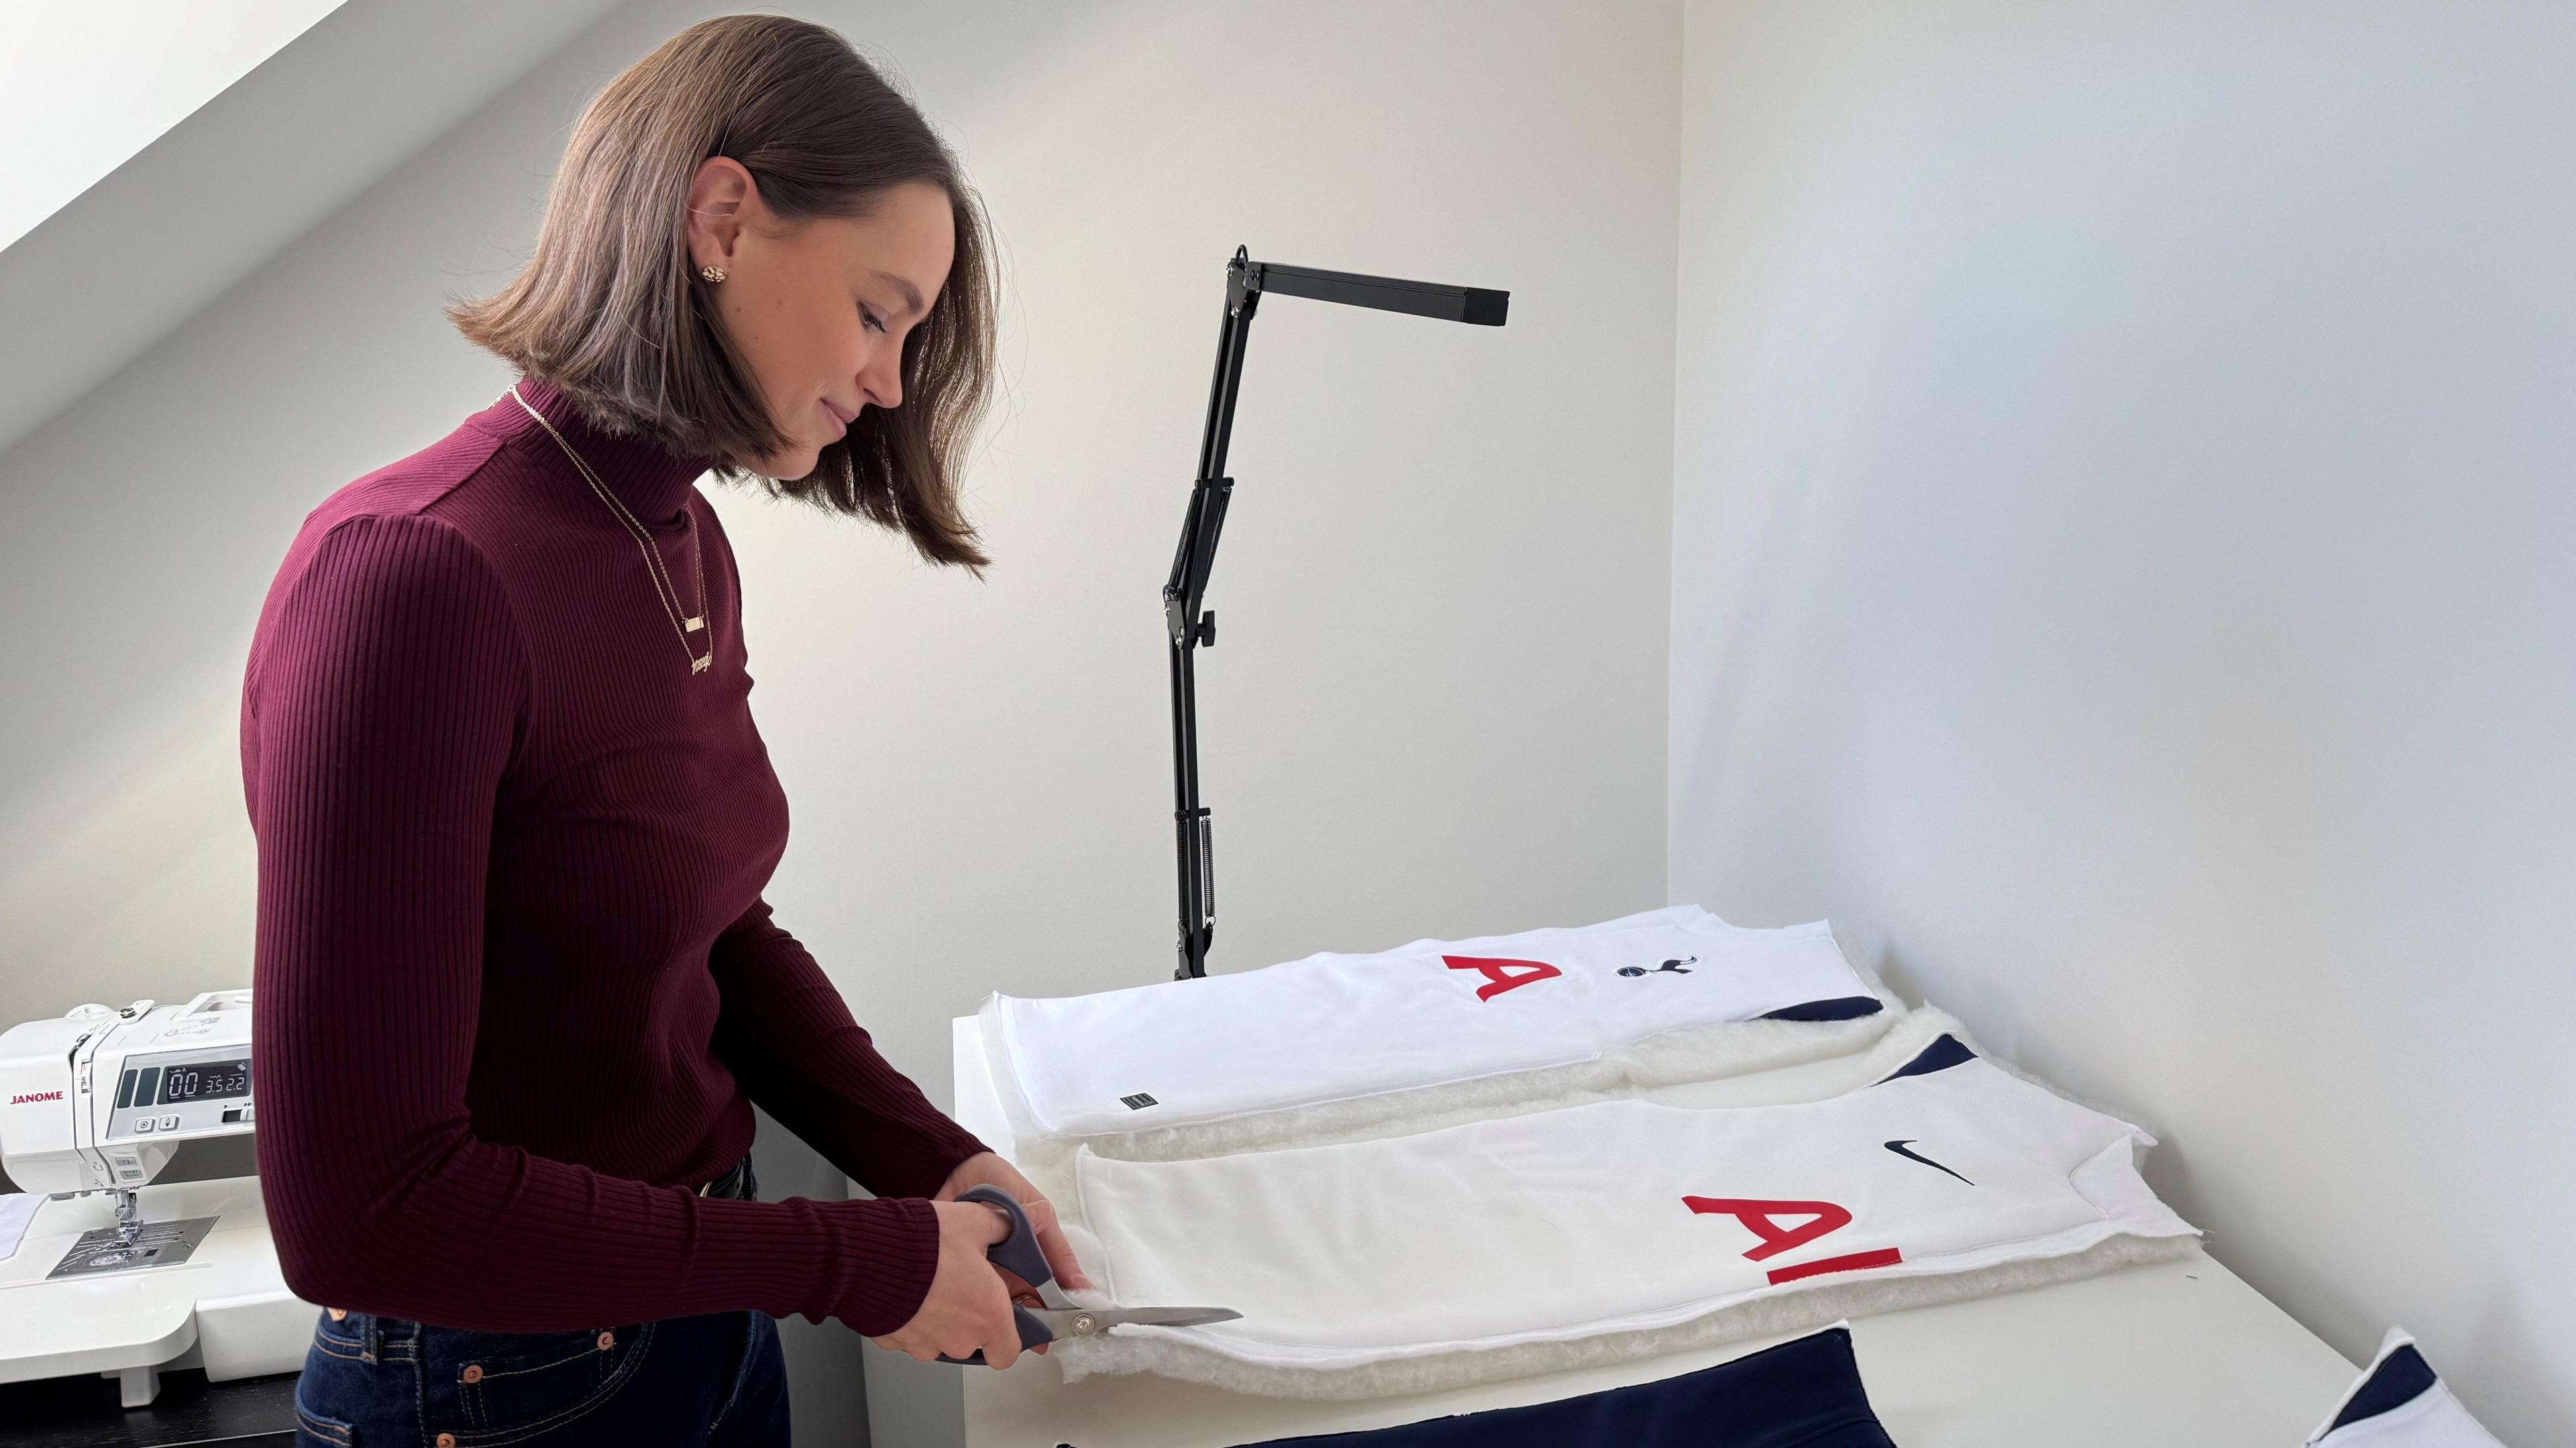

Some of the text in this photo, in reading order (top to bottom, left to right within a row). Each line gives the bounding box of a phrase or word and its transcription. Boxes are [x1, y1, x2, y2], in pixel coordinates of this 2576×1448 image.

[1442, 954, 1562, 1002] A
[169, 1072, 244, 1097] 00 3.5 2.2
[10, 1091, 63, 1105] JANOME
